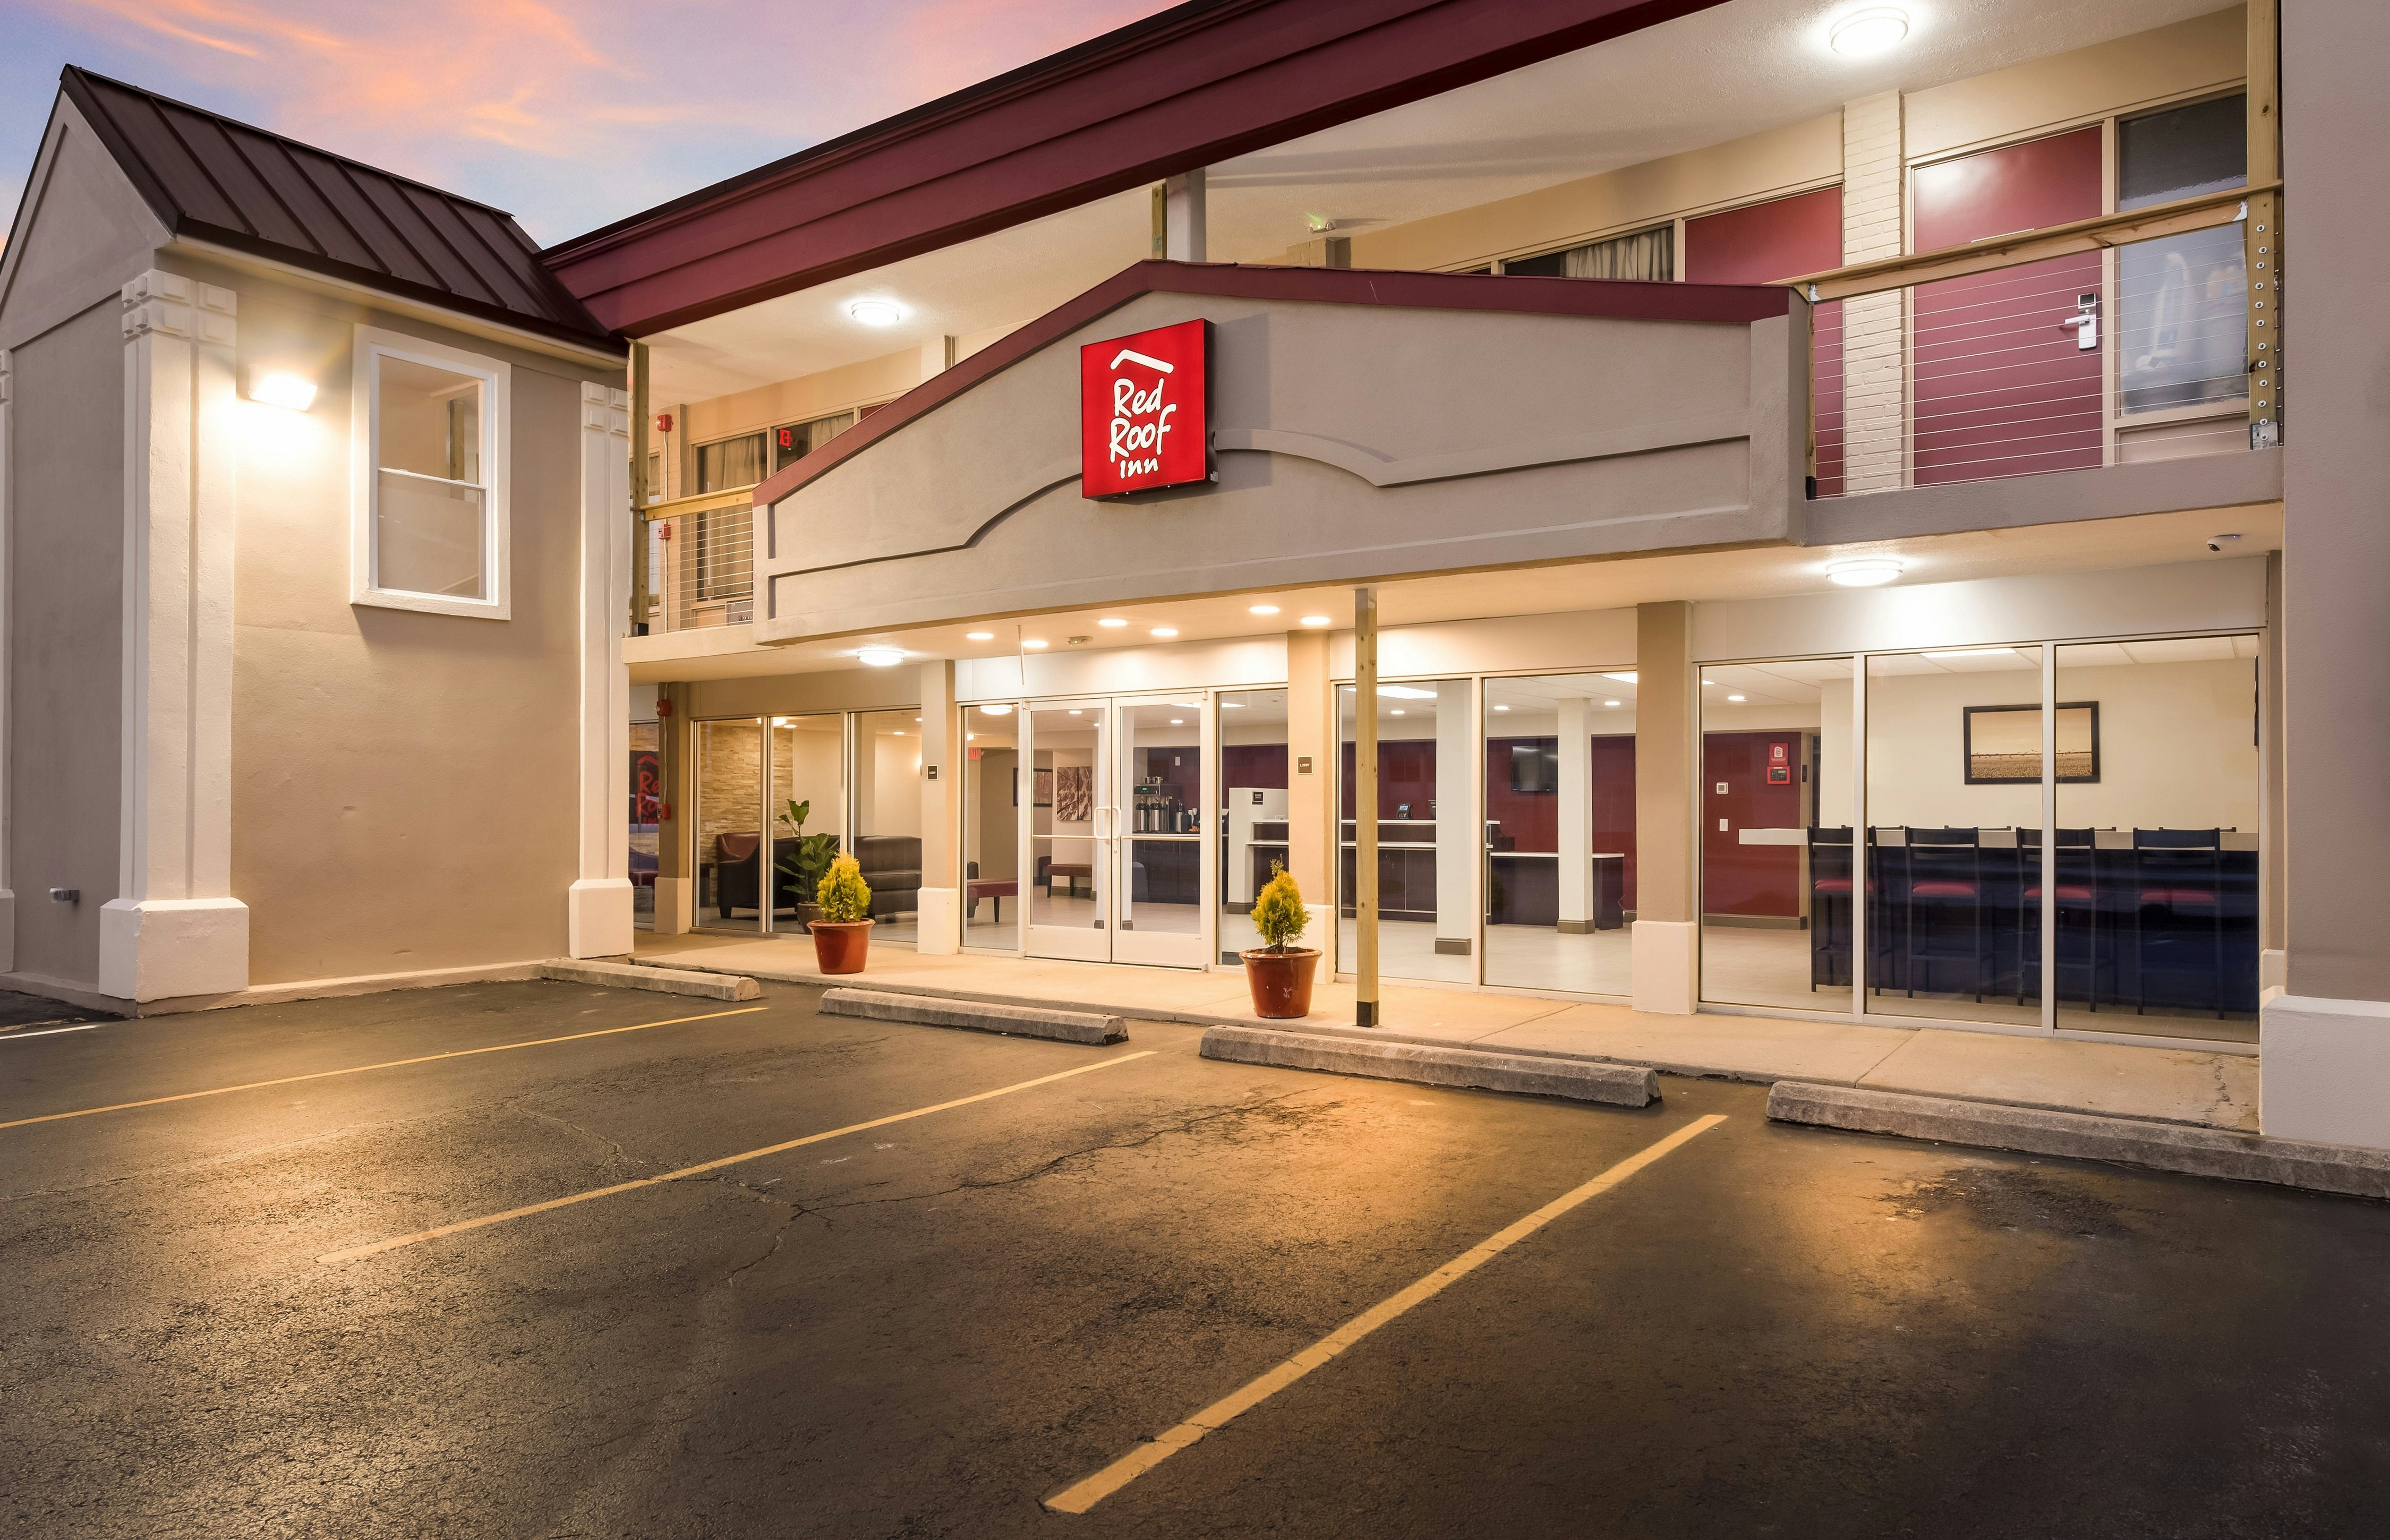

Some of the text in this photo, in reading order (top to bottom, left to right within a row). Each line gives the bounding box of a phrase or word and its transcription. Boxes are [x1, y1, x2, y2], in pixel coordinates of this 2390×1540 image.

[1114, 378, 1164, 418] Red
[1109, 404, 1177, 463] Roof
[639, 771, 659, 793] Re
[636, 792, 659, 817] Ro
